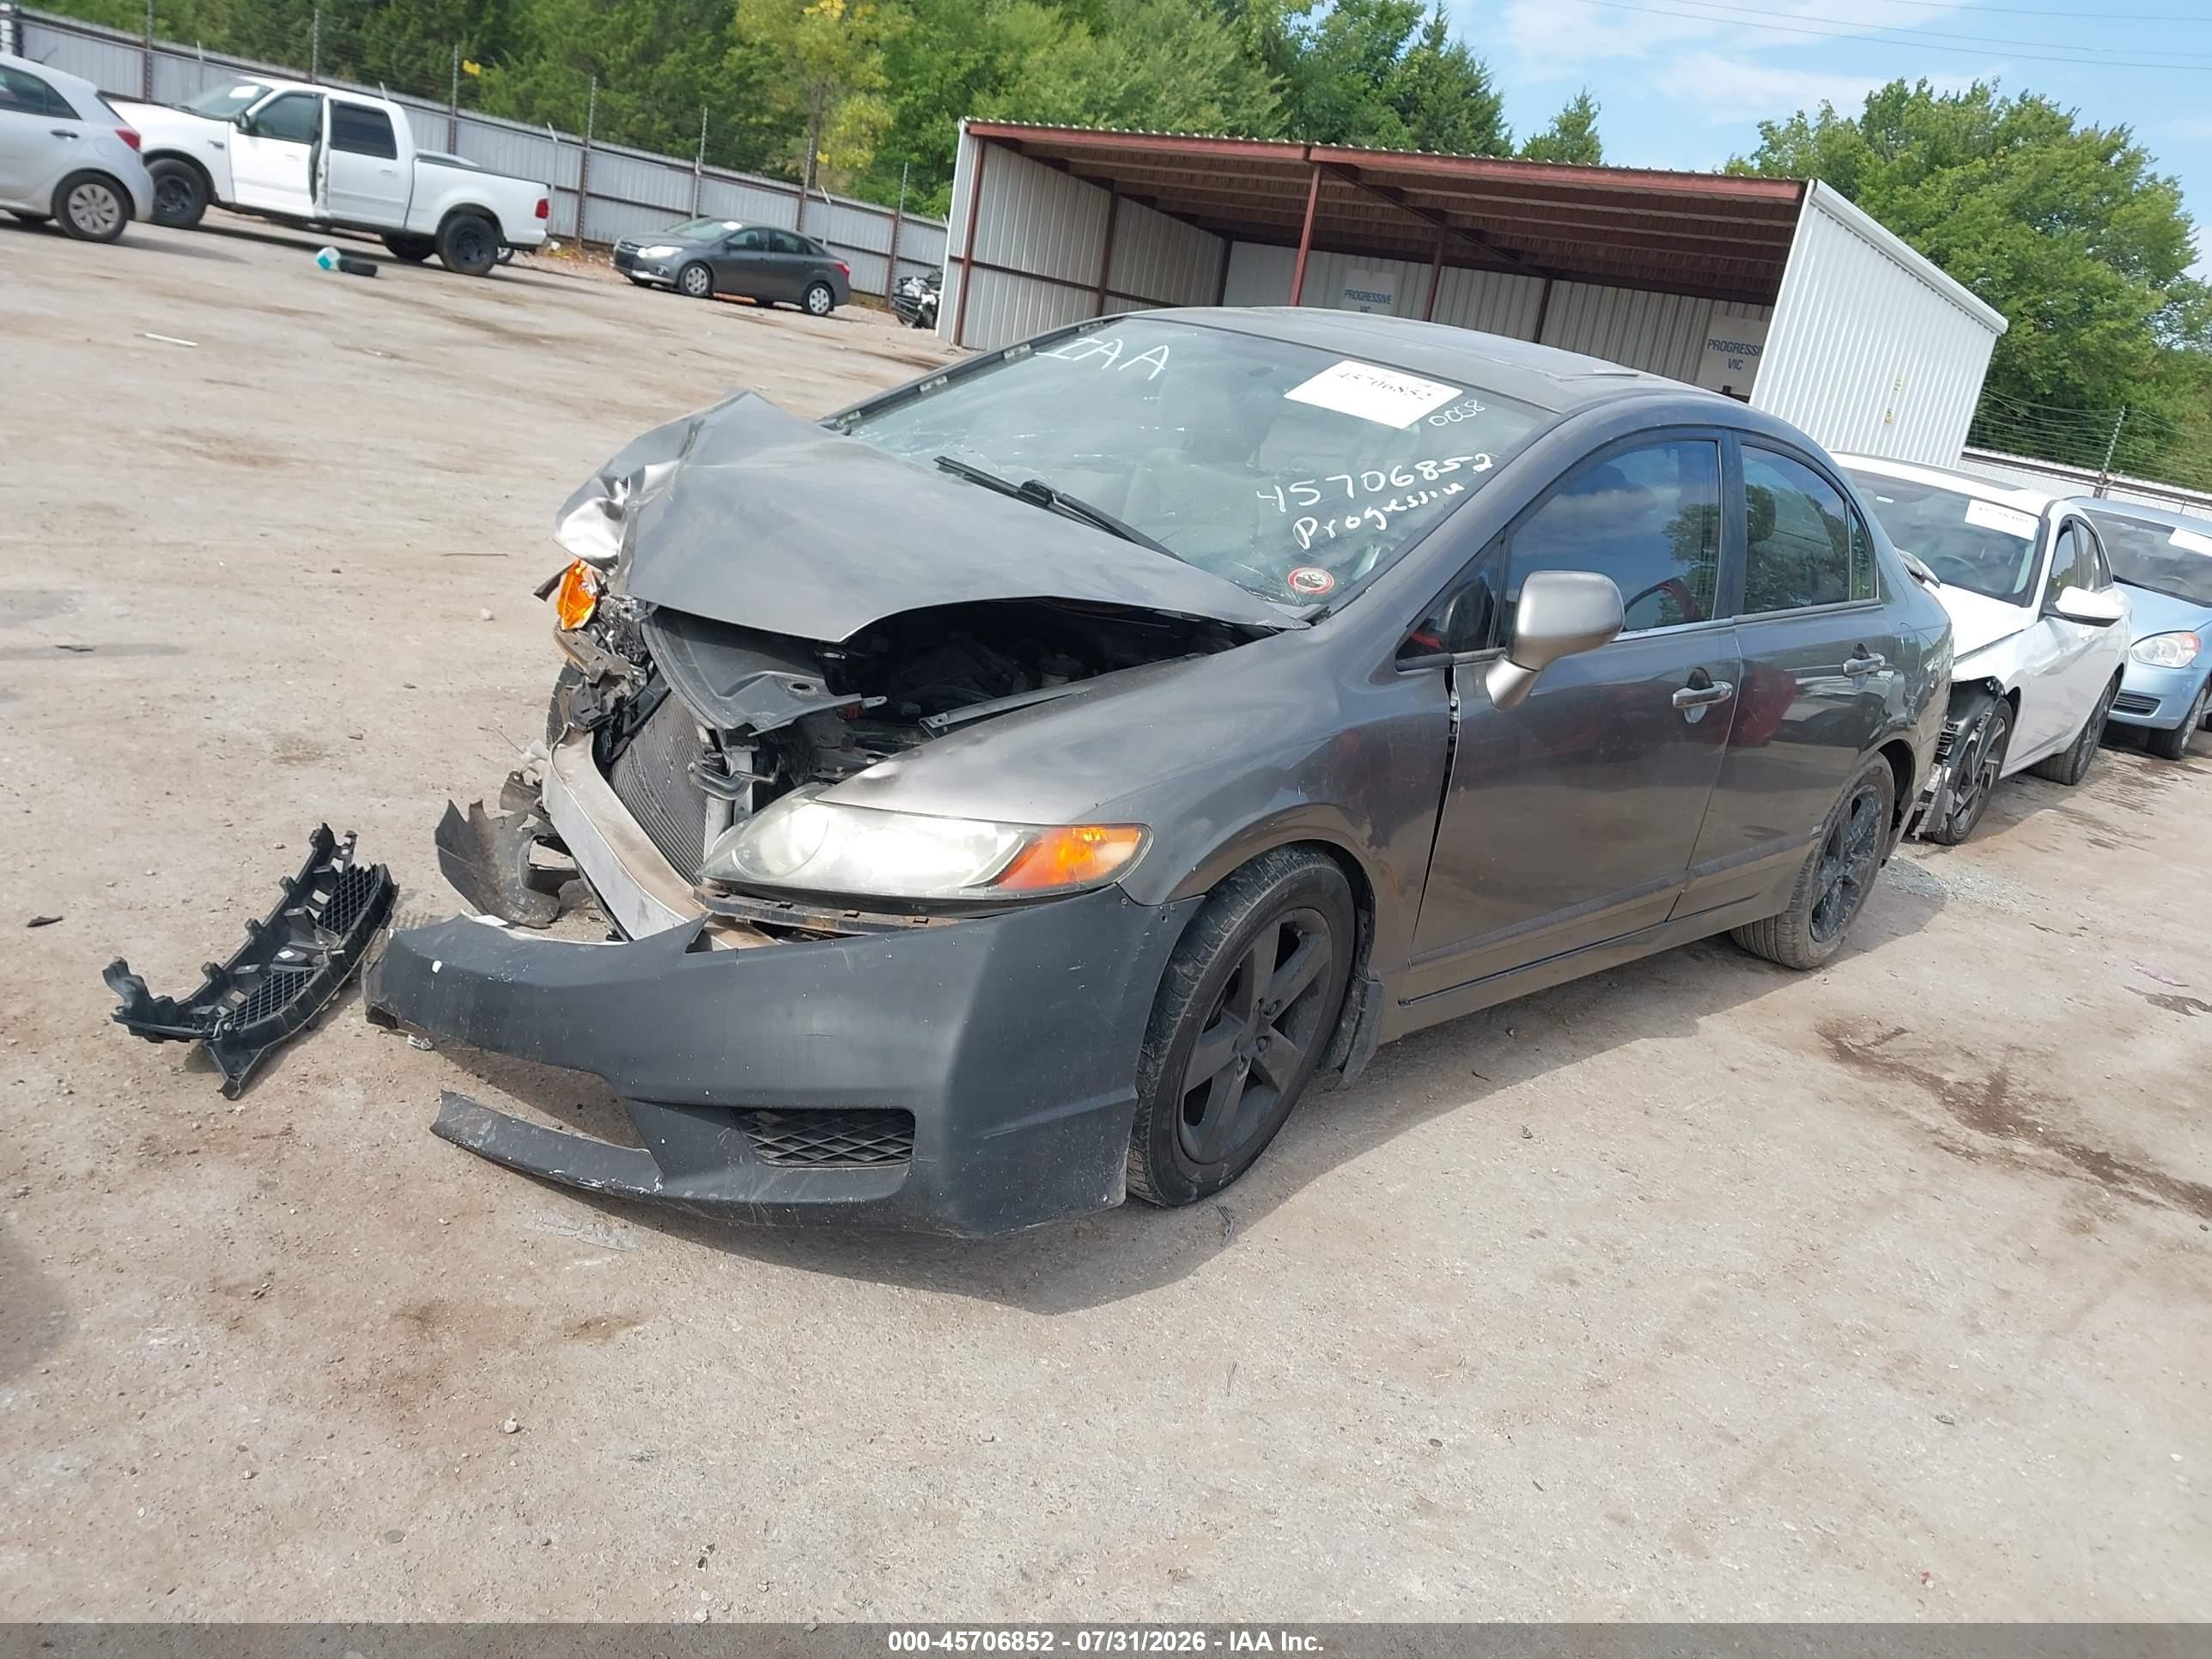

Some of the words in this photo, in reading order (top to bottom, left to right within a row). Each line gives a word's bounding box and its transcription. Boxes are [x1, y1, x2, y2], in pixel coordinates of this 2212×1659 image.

[1345, 289, 1392, 305] PROGRESSIVE
[1035, 337, 1169, 380] IAA
[1728, 357, 1744, 370] VIC
[1256, 453, 1494, 513] 45706852
